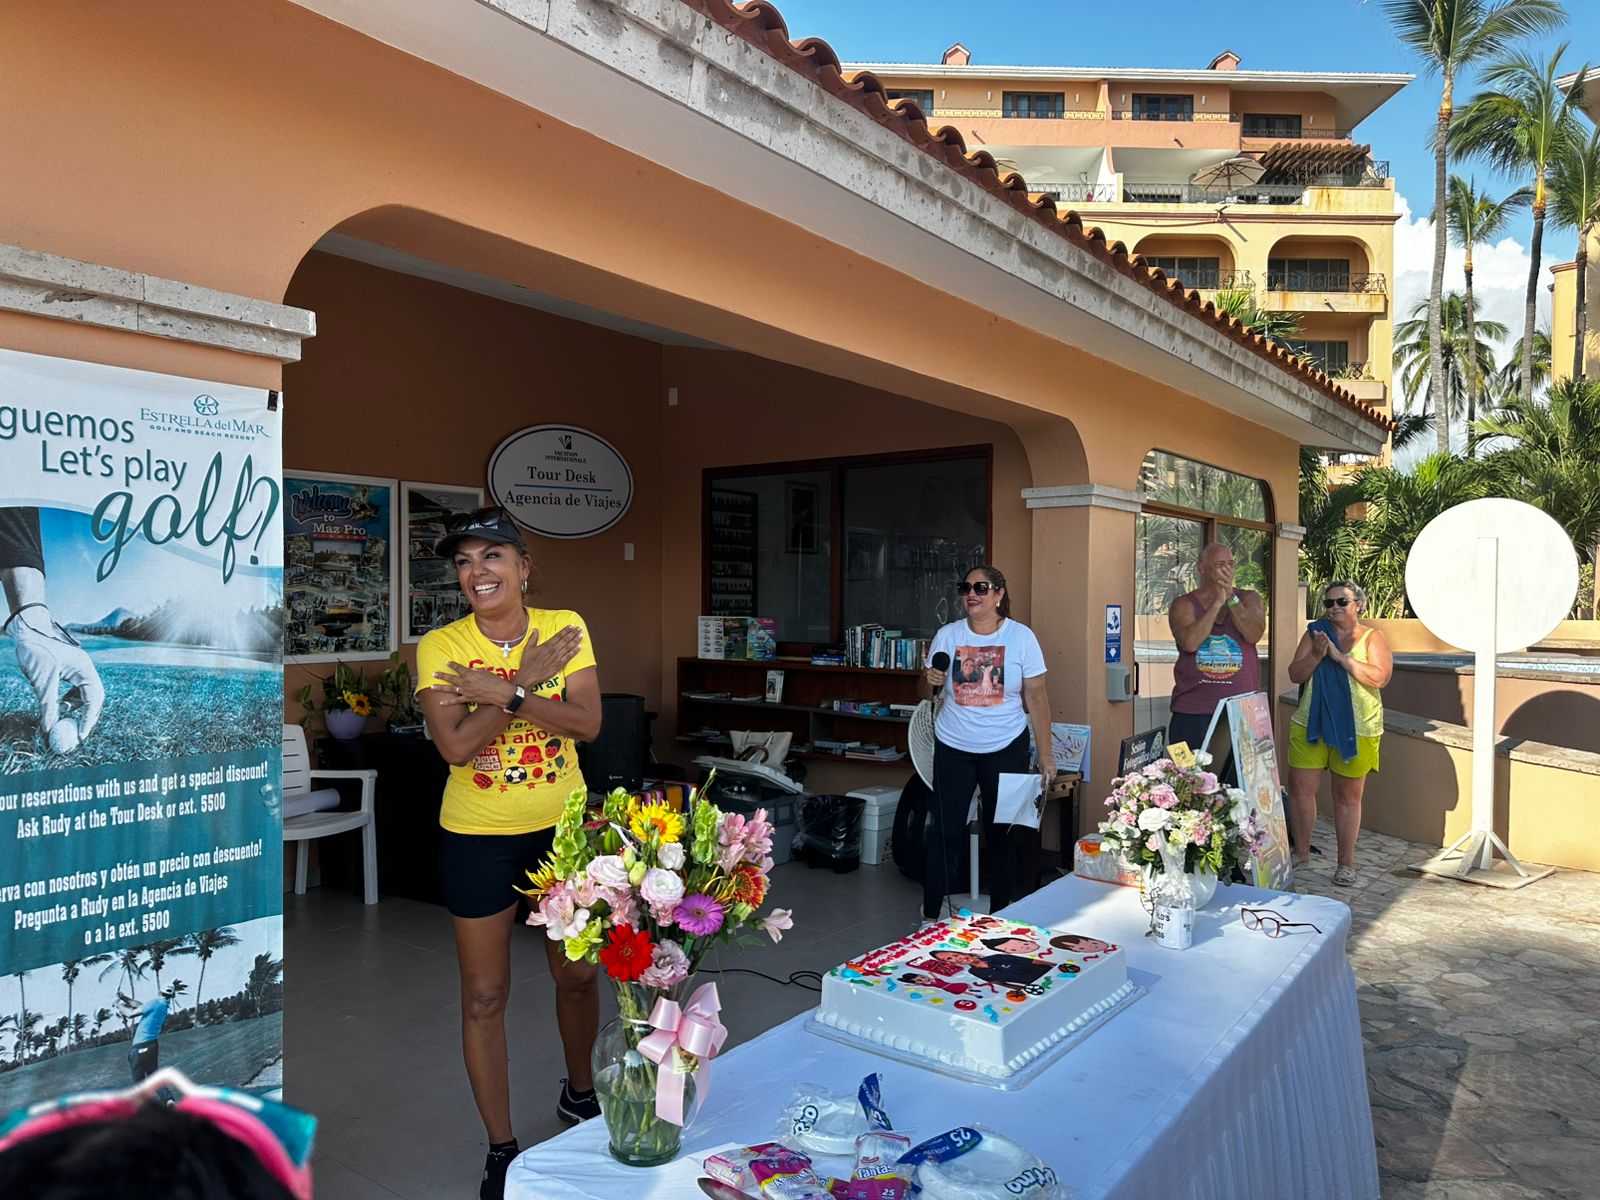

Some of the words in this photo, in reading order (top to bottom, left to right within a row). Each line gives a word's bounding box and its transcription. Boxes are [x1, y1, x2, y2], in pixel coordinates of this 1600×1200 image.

[41, 440, 114, 477] Let's
[125, 449, 187, 491] play
[527, 466, 561, 481] Tour
[565, 469, 597, 483] Desk
[91, 451, 280, 585] golf?
[323, 513, 335, 522] to
[505, 490, 561, 507] Agencia
[565, 493, 581, 506] de
[584, 494, 622, 510] Viajes
[312, 523, 340, 534] Maz
[343, 524, 366, 535] Pro
[21, 783, 93, 807] reservations
[96, 778, 121, 798] with
[123, 780, 136, 795] us
[139, 774, 158, 794] and
[161, 774, 178, 796] get
[180, 774, 186, 788] a
[189, 766, 223, 791] special
[226, 761, 268, 783] discount!
[17, 818, 38, 839] Ask
[42, 812, 71, 837] Rudy
[74, 813, 86, 831] at
[89, 808, 107, 828] the
[110, 806, 134, 826] Tour
[137, 801, 163, 822] Desk
[166, 803, 176, 818] or
[178, 800, 197, 816] ext.
[201, 791, 226, 813] 5500
[0, 884, 20, 902] rva
[24, 879, 46, 898] con
[49, 871, 97, 894] nosotros
[100, 869, 108, 886] y
[110, 859, 140, 884] obtén
[143, 862, 156, 877] un
[159, 852, 190, 879] precio
[193, 850, 211, 867] con
[213, 838, 262, 864] descuento!
[14, 904, 67, 931] Pregunta
[70, 905, 78, 919] a
[81, 895, 108, 918] Rudy
[112, 895, 125, 911] en
[127, 890, 138, 907] la
[141, 881, 182, 905] Agencia
[184, 878, 197, 896] de
[199, 873, 228, 895] Viajes
[84, 930, 91, 945] o
[95, 928, 102, 943] a
[105, 922, 116, 941] la
[118, 920, 139, 938] ext.
[142, 910, 170, 933] 5500
